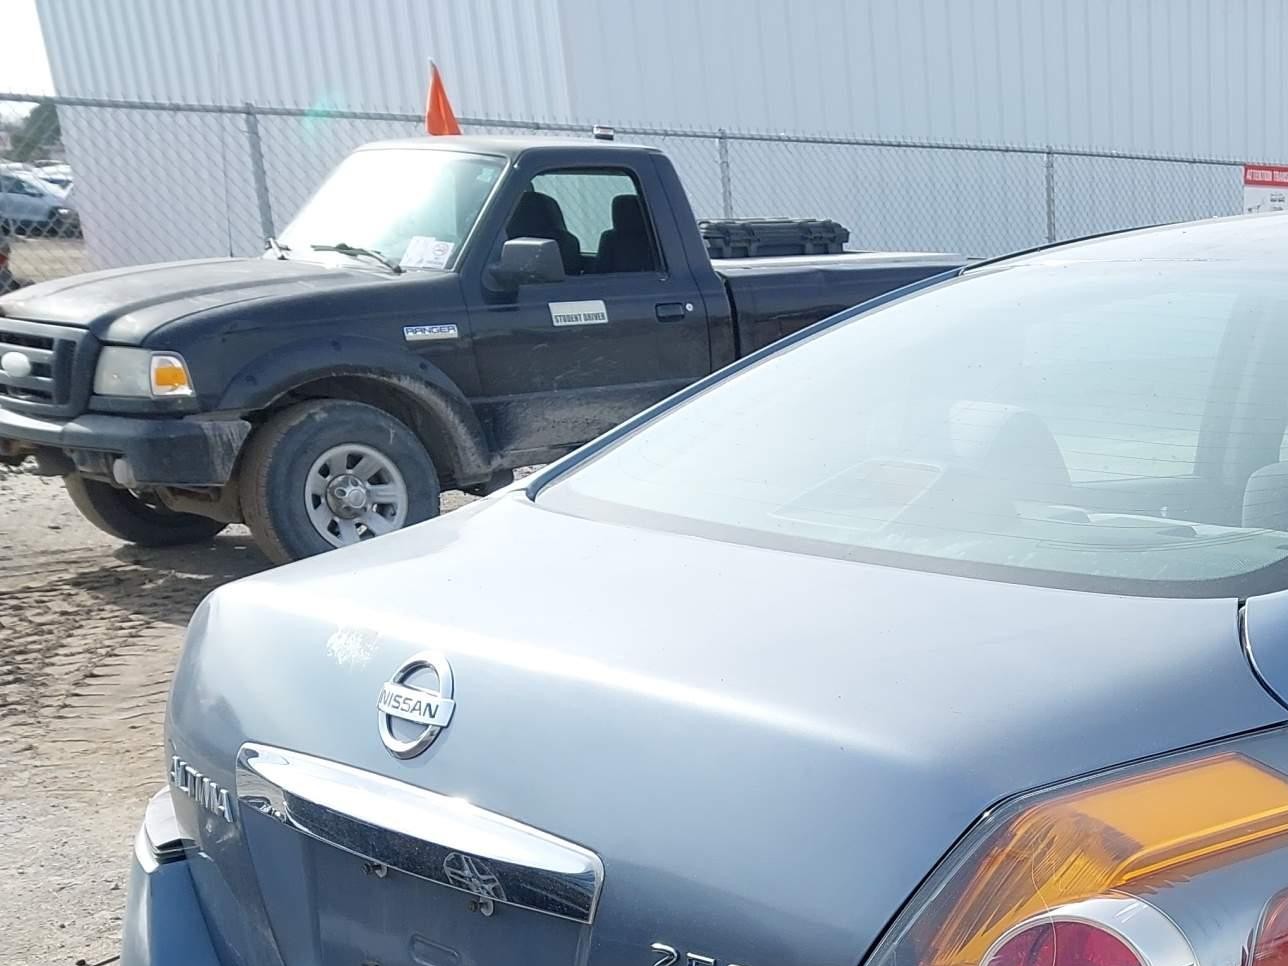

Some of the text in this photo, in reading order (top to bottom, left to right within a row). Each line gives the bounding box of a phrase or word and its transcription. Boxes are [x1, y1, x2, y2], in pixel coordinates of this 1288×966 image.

[554, 312, 606, 324] STUDENT DRIVER
[405, 325, 457, 335] RANGER
[379, 689, 440, 719] NISSAN
[170, 755, 234, 823] ALTIMA
